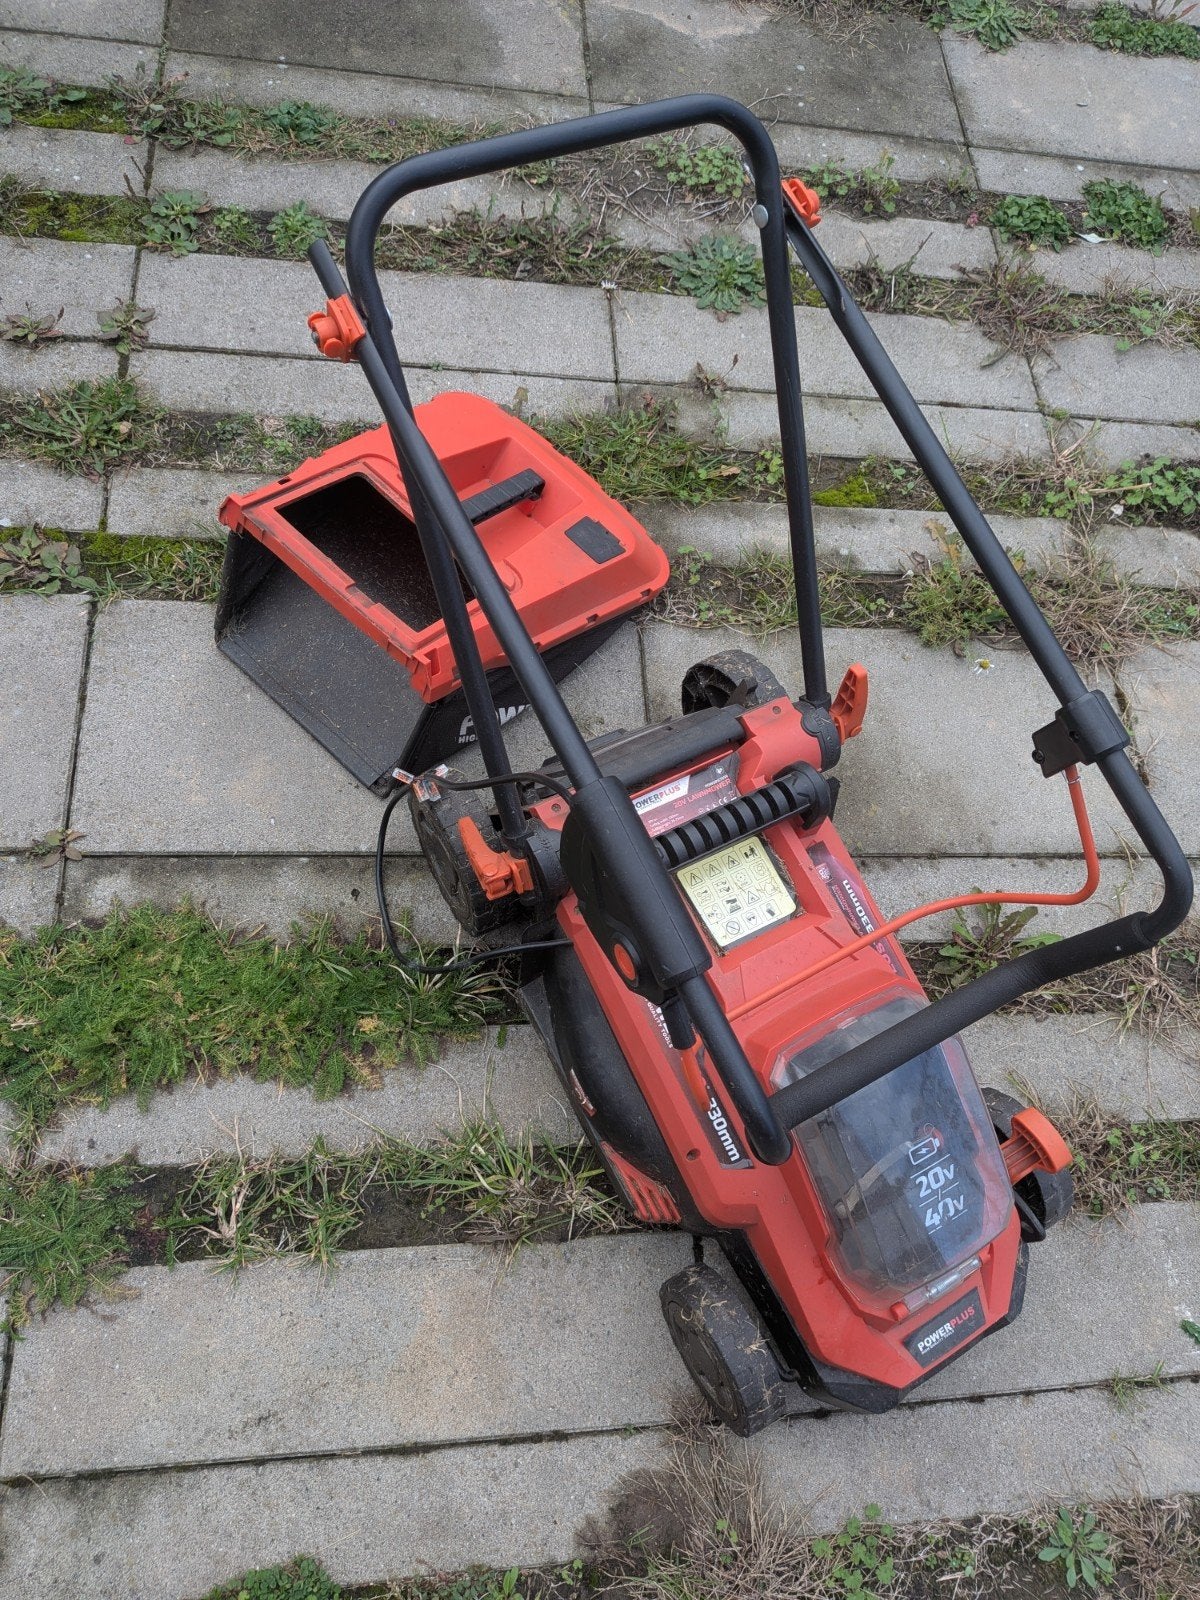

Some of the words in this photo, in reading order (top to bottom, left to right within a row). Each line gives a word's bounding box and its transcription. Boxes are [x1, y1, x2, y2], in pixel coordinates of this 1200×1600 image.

[458, 734, 478, 743] HIG
[635, 783, 681, 810] OWERPLUS
[646, 1001, 663, 1029] QUALITY
[660, 1026, 674, 1049] TOOLS
[917, 1306, 975, 1353] POWERPLUS
